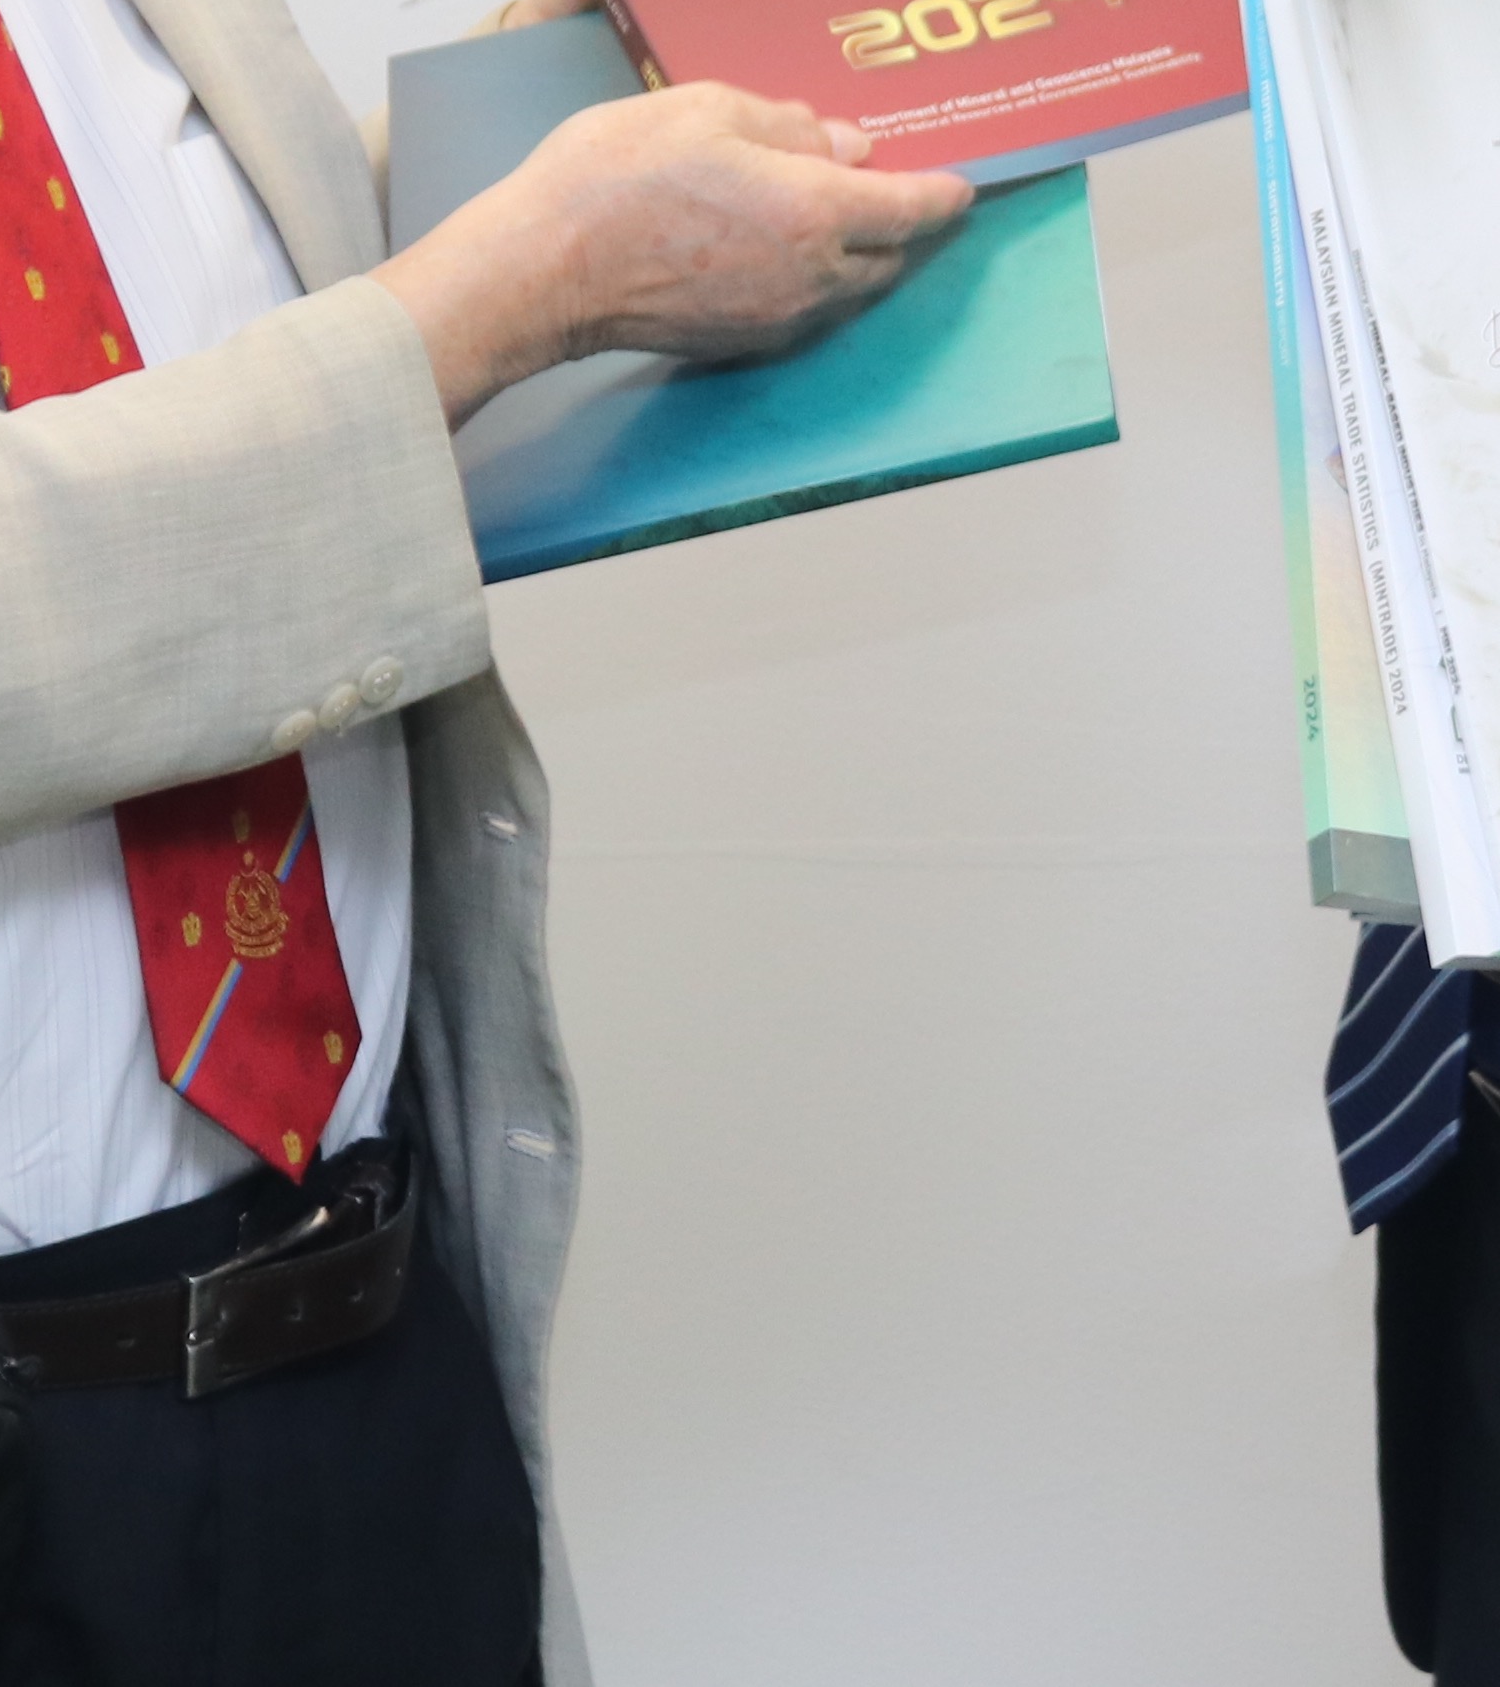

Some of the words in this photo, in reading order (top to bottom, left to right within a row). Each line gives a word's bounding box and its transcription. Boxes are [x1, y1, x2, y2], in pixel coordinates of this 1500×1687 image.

[858, 104, 939, 129] Department
[940, 99, 954, 113] of
[954, 88, 1007, 108] Mineral
[1009, 80, 1035, 99] and
[1035, 62, 1112, 90] Geoscience
[1112, 44, 1173, 70] Malaysia
[1310, 208, 1339, 307] MALAYSIAN
[1327, 311, 1352, 392] MINERAL
[1341, 392, 1363, 454] TRADE
[1351, 452, 1380, 551] STATISTICS
[1368, 560, 1398, 666] (MINTRADE)
[1303, 675, 1320, 742] 2024
[1388, 669, 1408, 717] 2024
